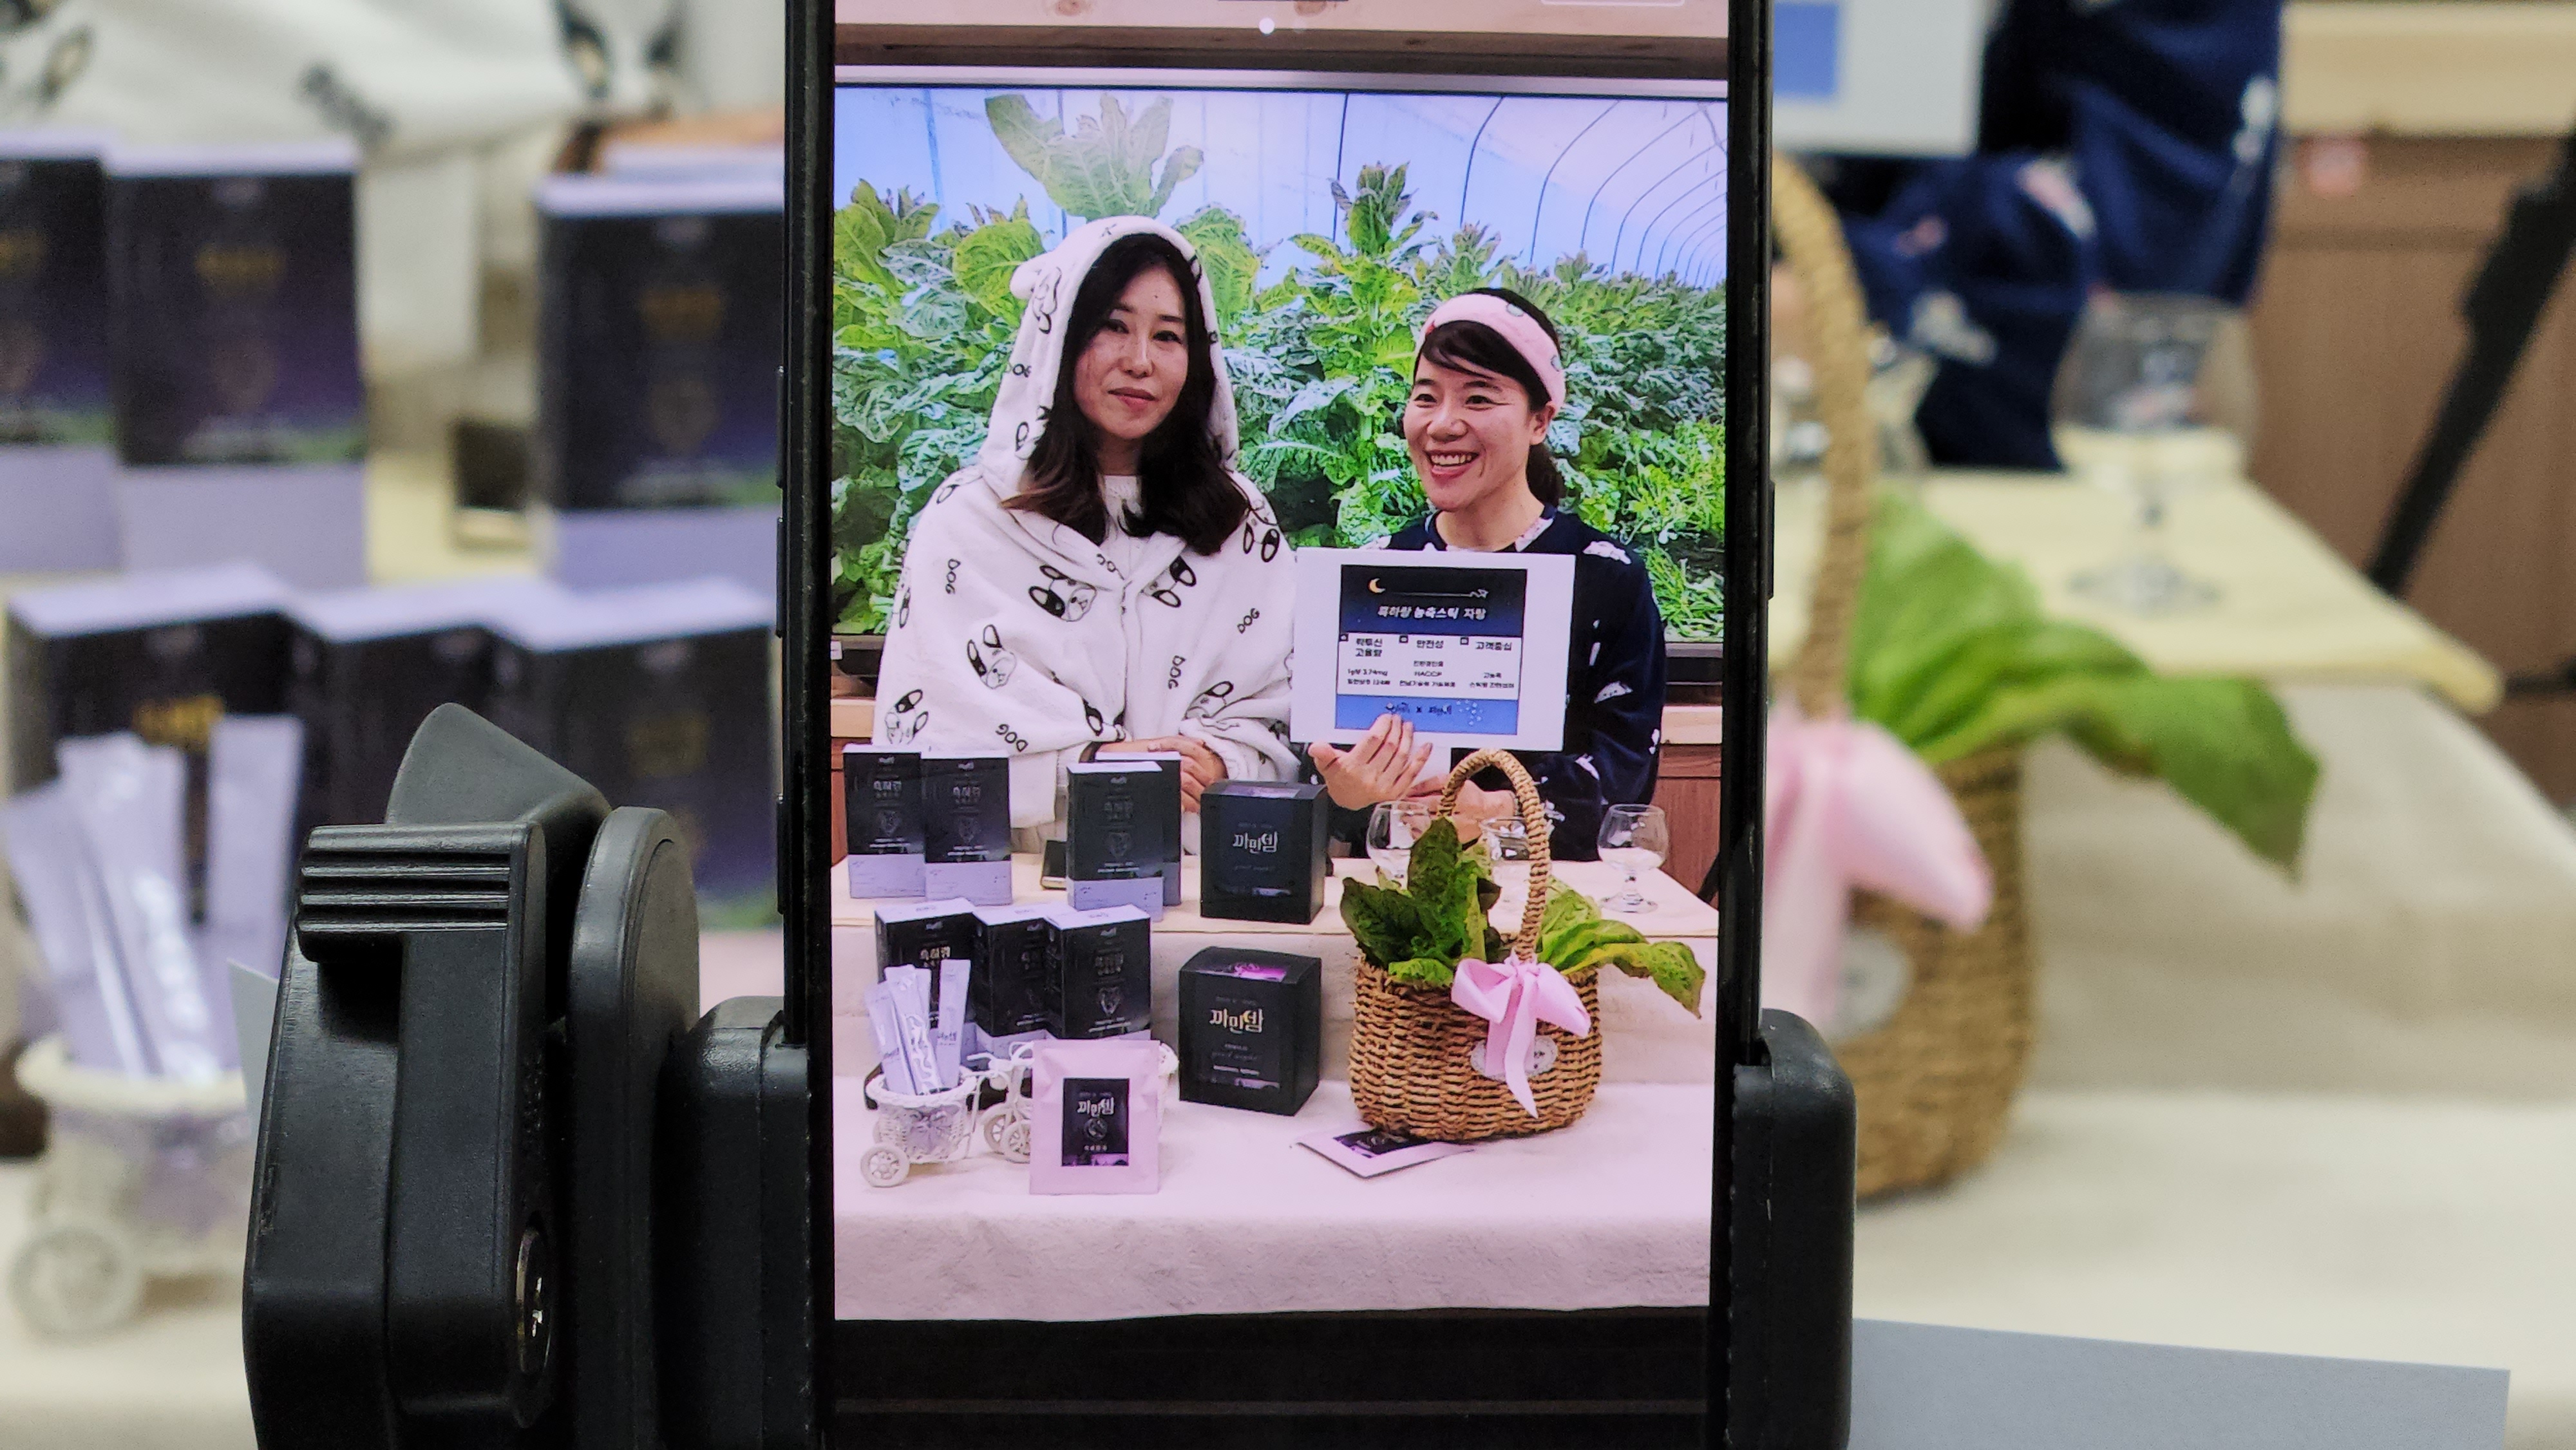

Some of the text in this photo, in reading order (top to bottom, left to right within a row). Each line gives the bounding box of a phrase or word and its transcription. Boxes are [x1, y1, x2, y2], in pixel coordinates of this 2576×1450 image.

[945, 558, 961, 594] DOG
[1236, 608, 1260, 634] DOG
[1168, 655, 1187, 690] DOG
[995, 724, 1029, 752] DOG
